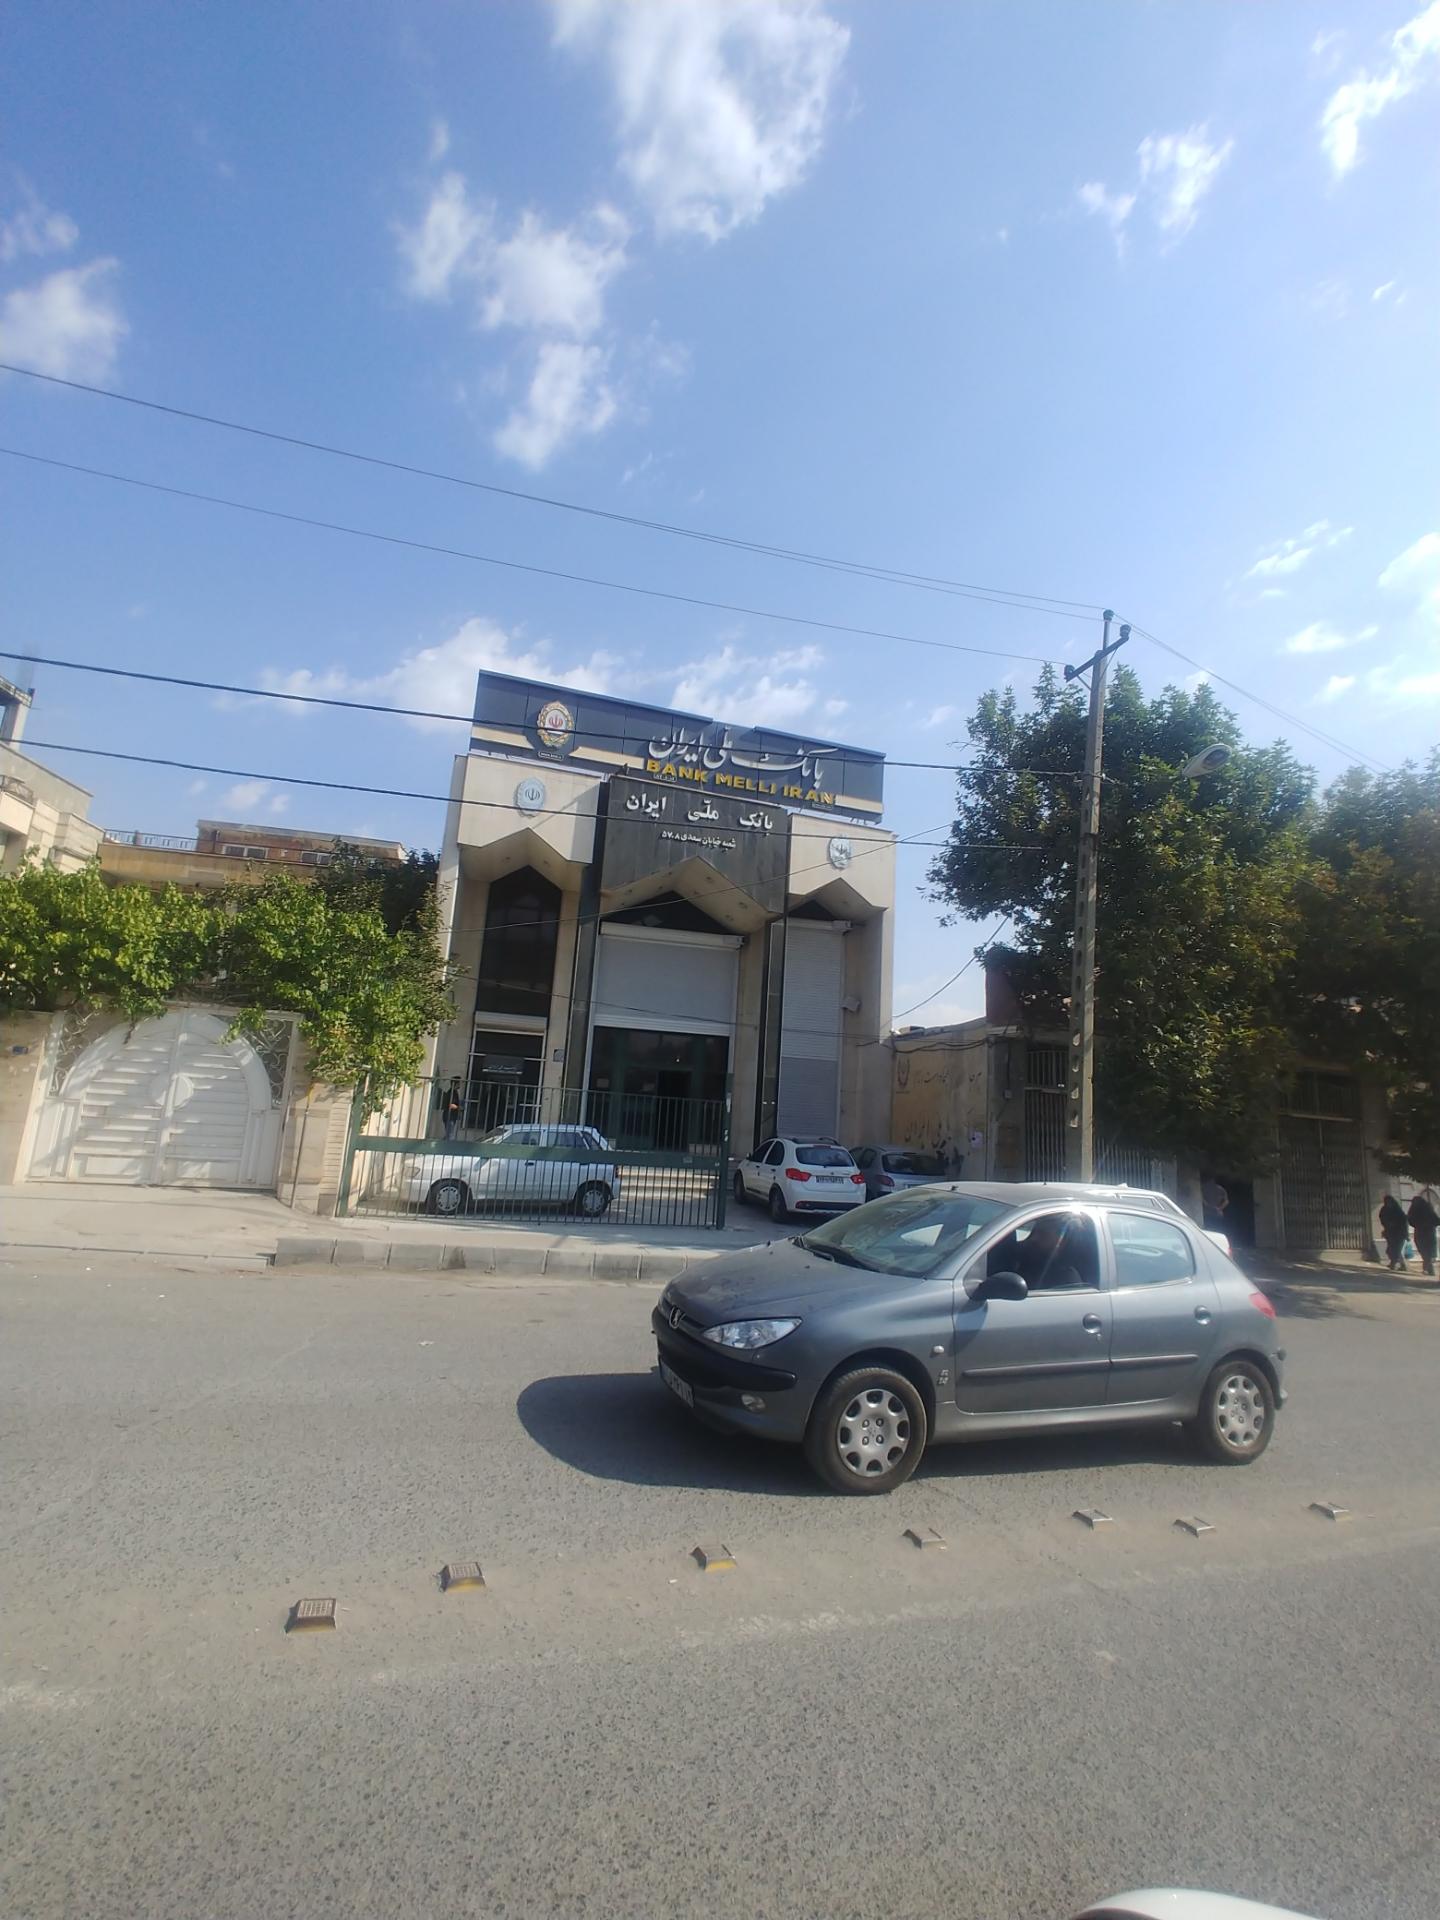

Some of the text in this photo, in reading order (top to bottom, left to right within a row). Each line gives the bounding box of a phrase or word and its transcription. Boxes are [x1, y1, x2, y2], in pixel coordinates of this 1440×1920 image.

[646, 759, 708, 784] BANK
[715, 773, 777, 795] MELLI
[783, 785, 837, 805] IRAN
[626, 793, 667, 818] ایران
[739, 811, 773, 836] بانک
